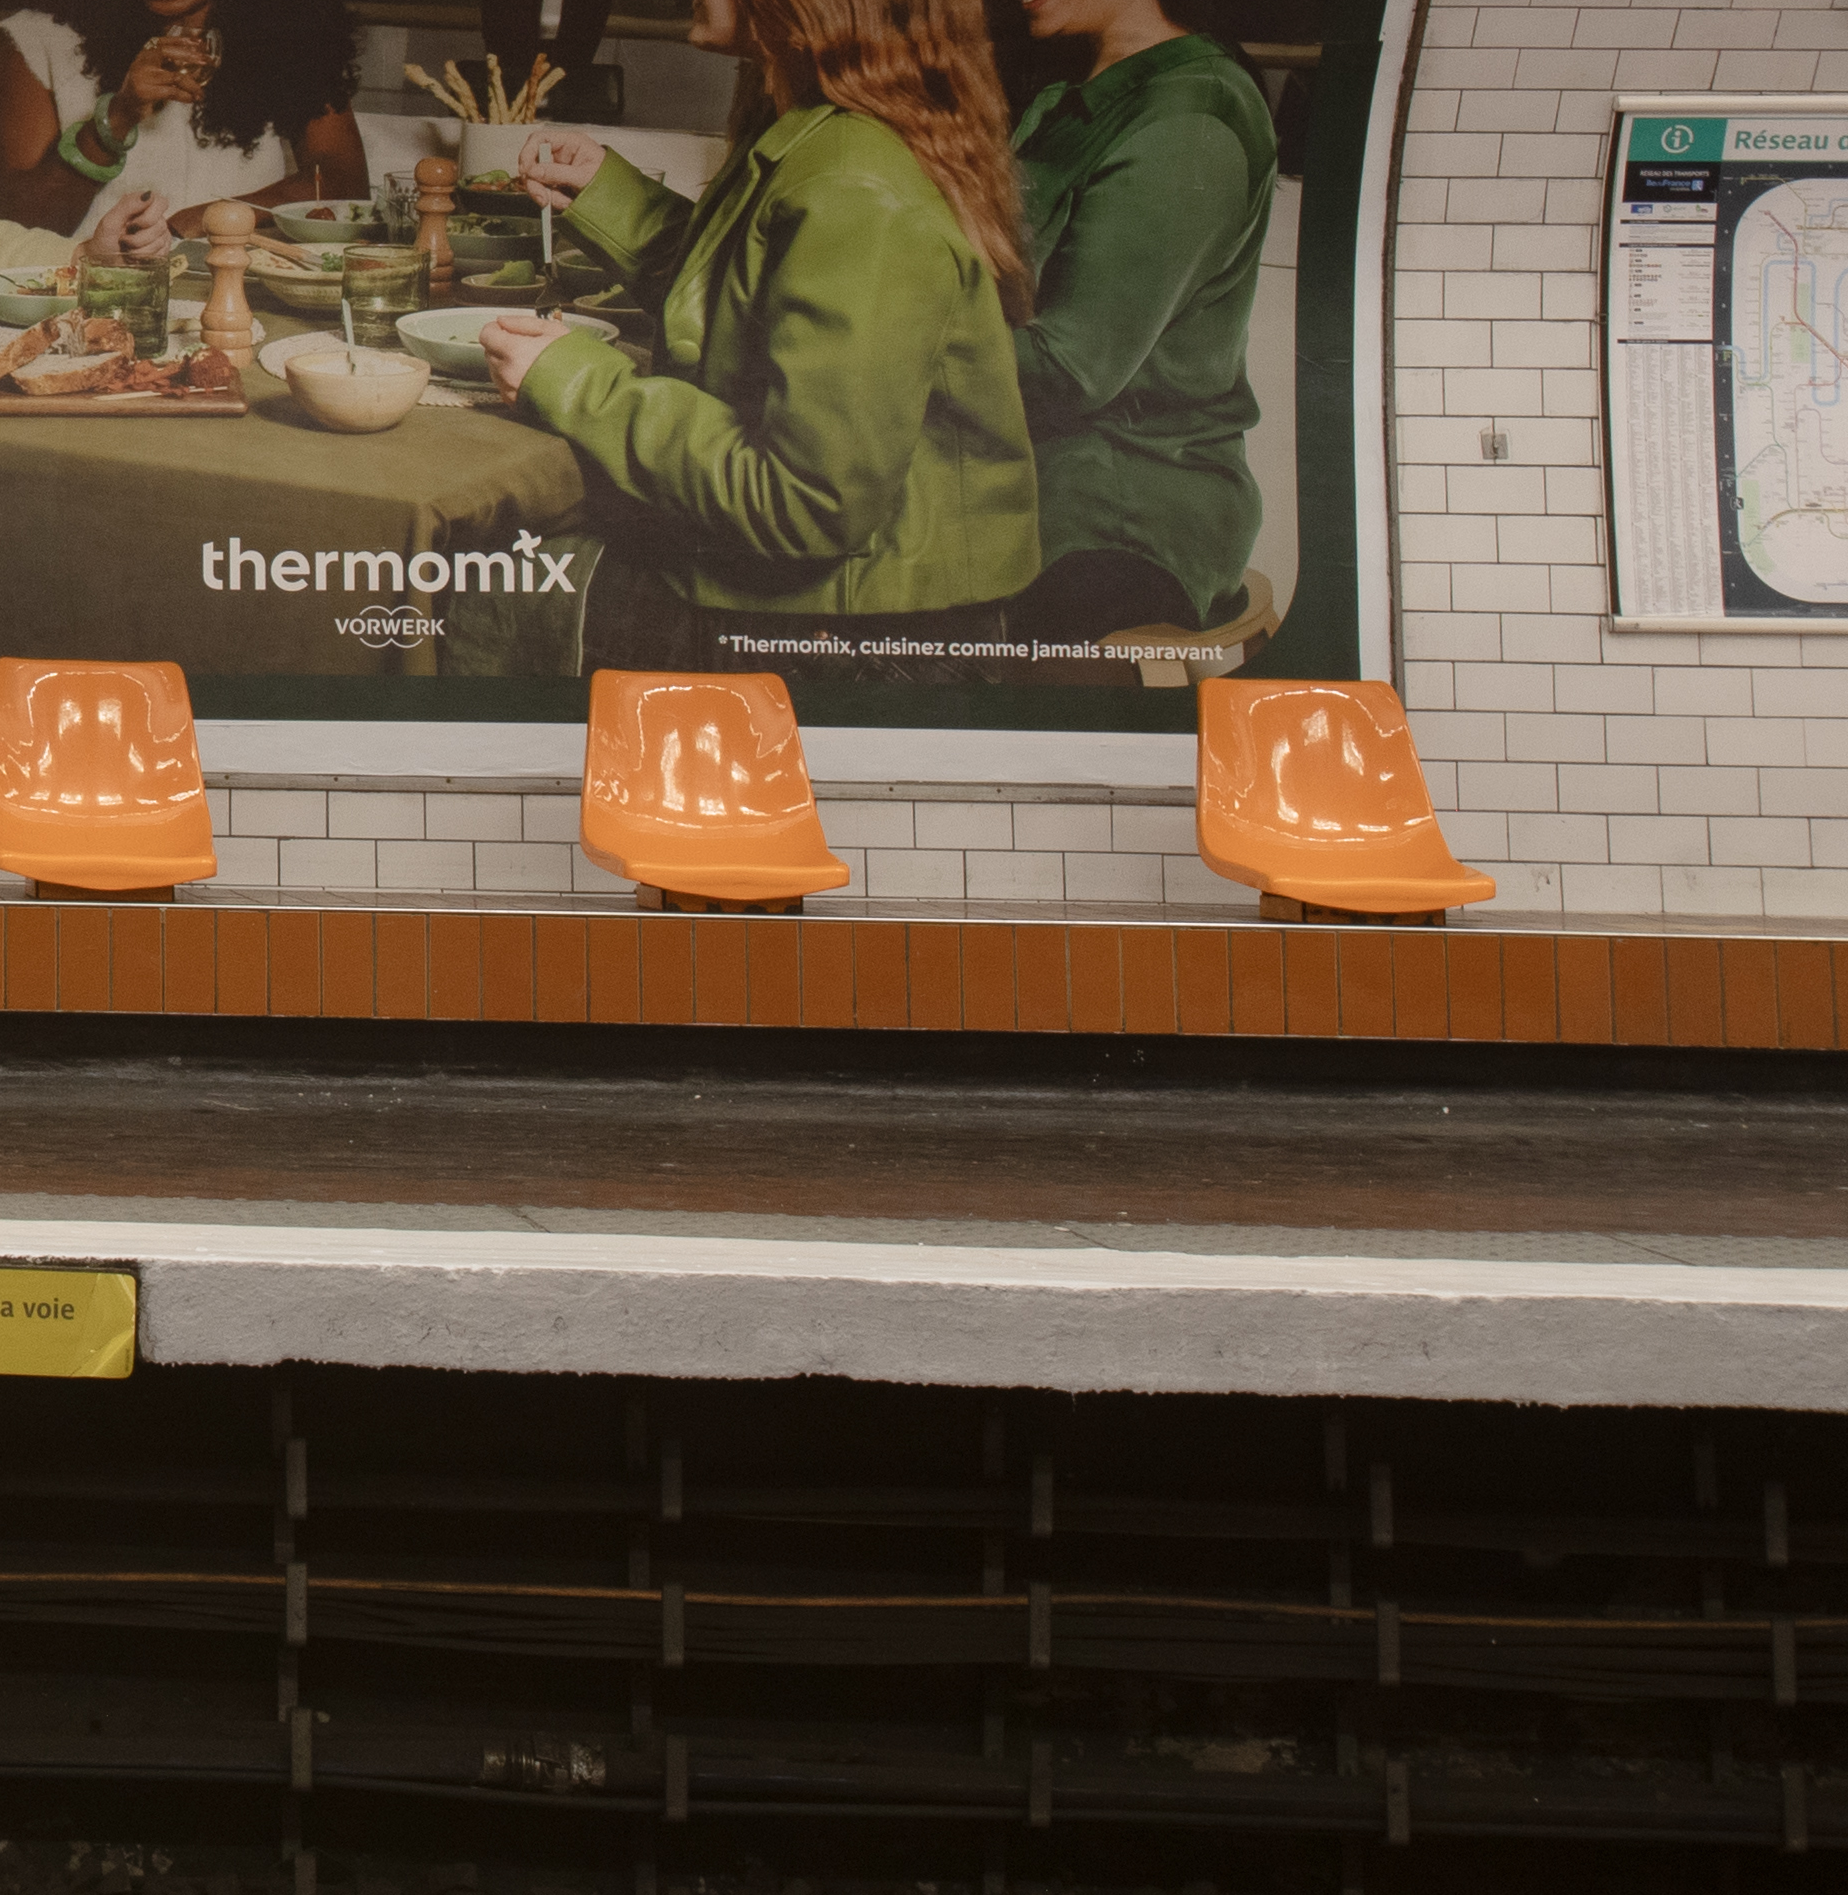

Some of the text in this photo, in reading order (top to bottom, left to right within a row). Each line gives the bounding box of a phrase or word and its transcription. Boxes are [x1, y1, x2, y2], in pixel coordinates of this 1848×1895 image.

[1735, 130, 1829, 151] Réseau
[203, 530, 576, 593] thermomix
[334, 617, 445, 637] VORWERK
[859, 637, 946, 656] cuisinez
[948, 642, 1029, 658] comme
[1031, 639, 1101, 662] jamais
[1104, 644, 1223, 664] auparavant
[22, 1297, 75, 1321] voie
